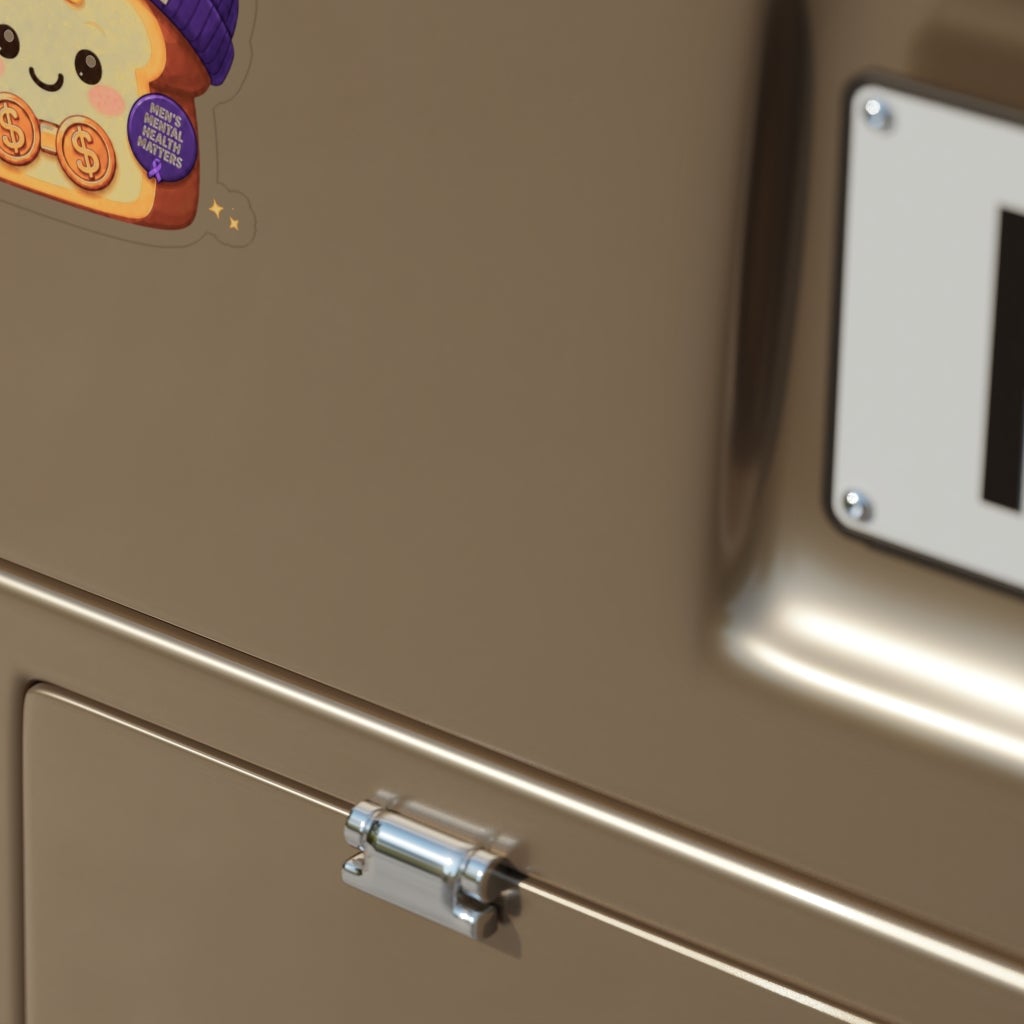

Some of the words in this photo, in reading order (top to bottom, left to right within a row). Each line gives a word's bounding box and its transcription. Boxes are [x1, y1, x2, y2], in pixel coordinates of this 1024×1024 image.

[143, 112, 183, 143] MENTAL
[149, 102, 182, 128] MEN'S
[71, 124, 102, 179] $
[137, 135, 183, 169] MATTERS
[142, 125, 182, 155] HEALTH
